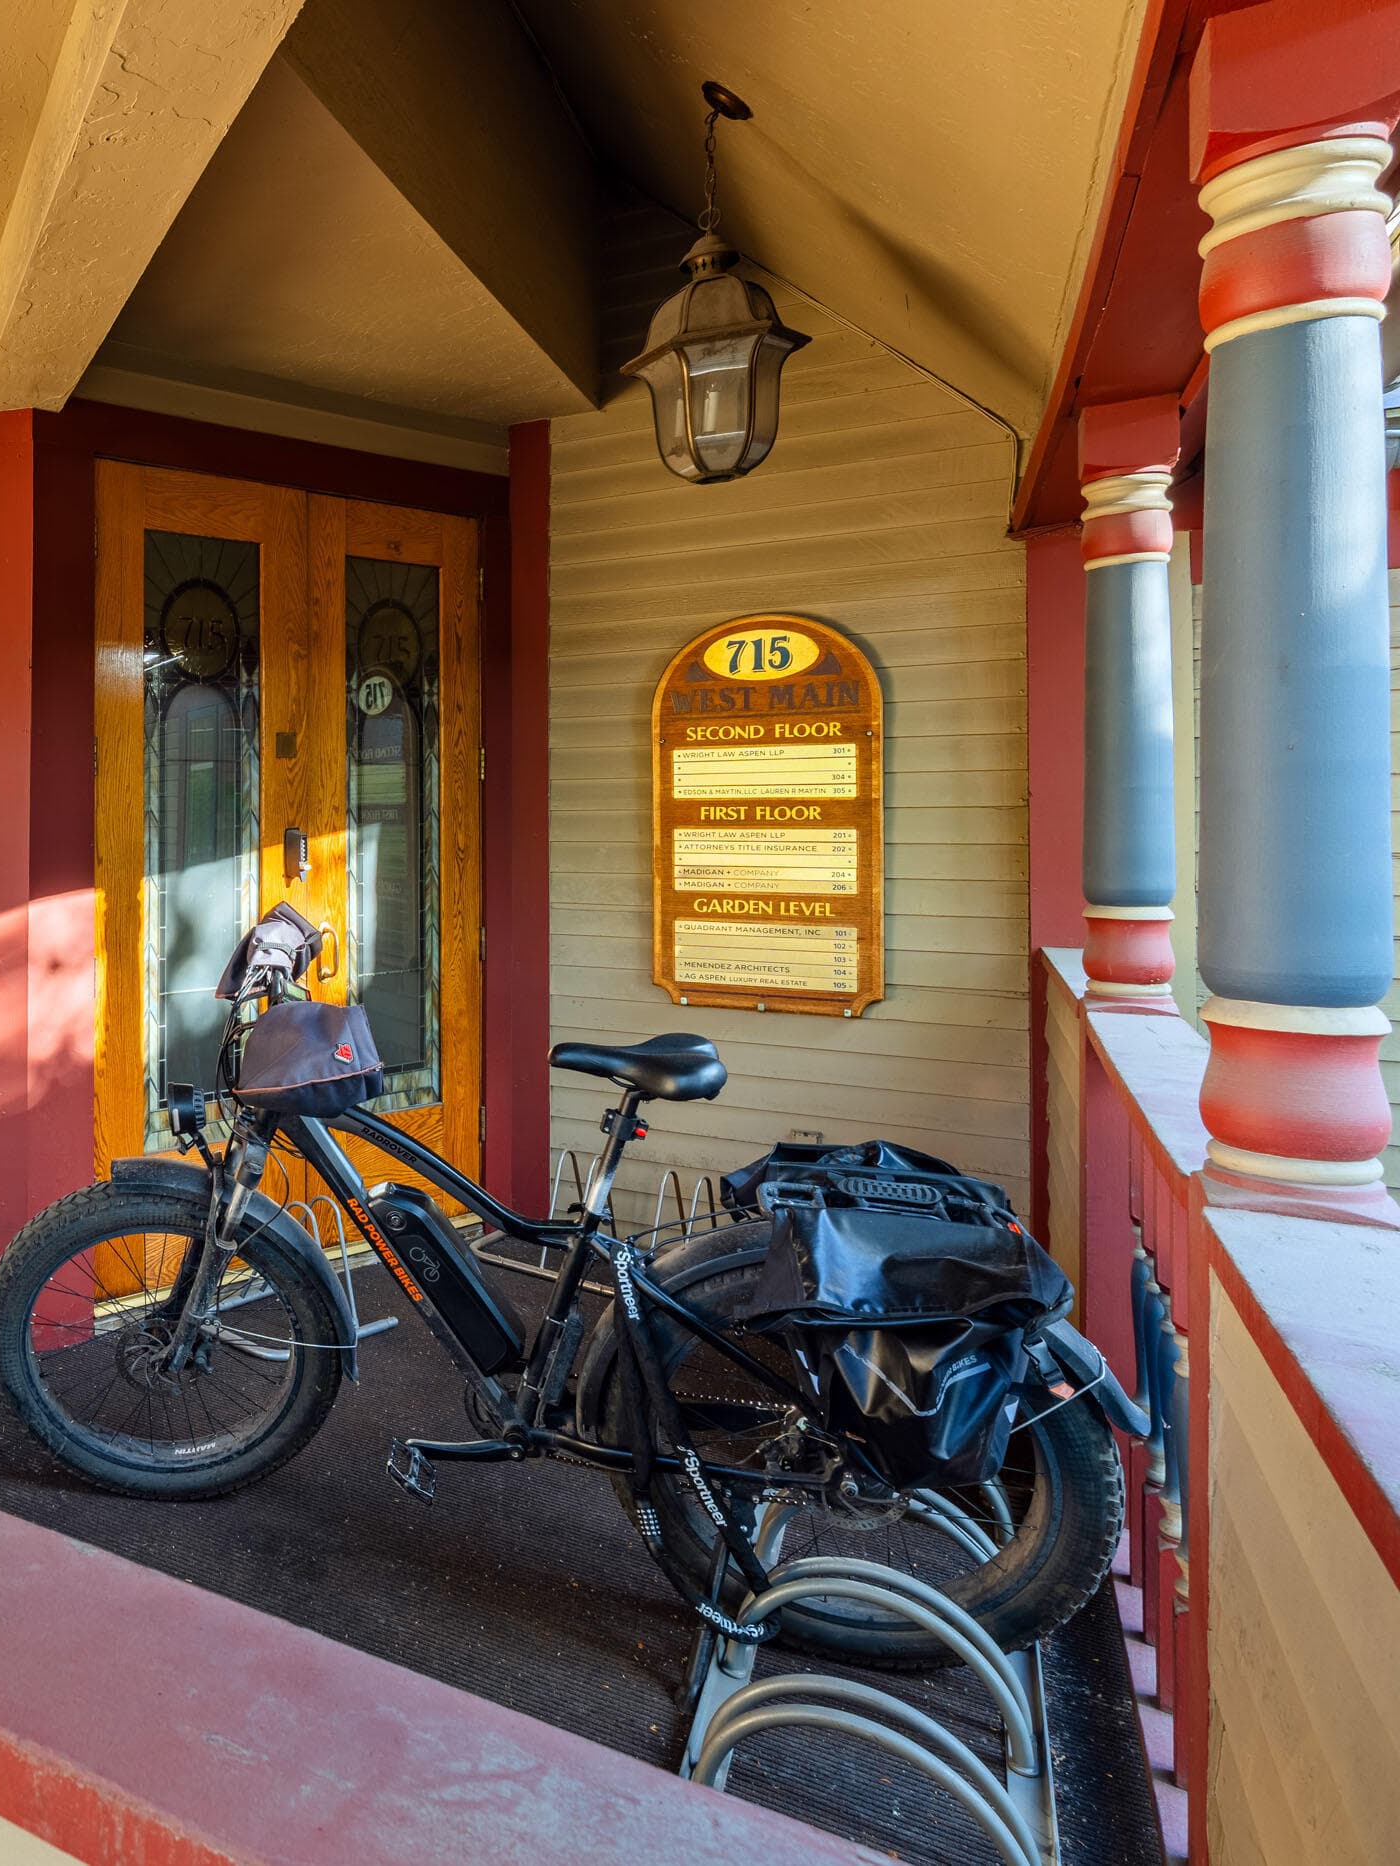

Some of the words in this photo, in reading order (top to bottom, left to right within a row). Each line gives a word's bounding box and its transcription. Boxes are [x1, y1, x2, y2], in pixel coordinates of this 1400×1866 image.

[177, 616, 227, 650] 715
[726, 636, 793, 675] 715
[670, 686, 757, 714] WEST
[768, 680, 861, 710] MAIN
[686, 725, 765, 742] SECOND
[774, 722, 843, 738] FLOOR
[831, 773, 846, 781] 304
[798, 787, 826, 795] MAYTIN
[699, 806, 749, 821] FIRST
[755, 806, 822, 821] FLOOR
[683, 843, 735, 851] ATTORNEYS
[733, 869, 780, 877] COMPANY
[733, 881, 780, 889] COMPANY
[693, 898, 774, 914] GARDEN
[779, 901, 836, 917] LEVEL
[683, 923, 733, 932] QUADRANT
[684, 961, 732, 970] MENENDEZ
[734, 964, 791, 973] ARCHITECTS
[698, 973, 726, 982] ASPEN
[780, 979, 808, 987] ESTATE
[360, 1127, 418, 1164] RADROVER
[347, 1197, 369, 1223] RAD
[363, 1222, 399, 1269] POWER
[392, 1267, 424, 1302] BIKES
[613, 1250, 641, 1320] Sportneer
[684, 1456, 728, 1527] Sportneer
